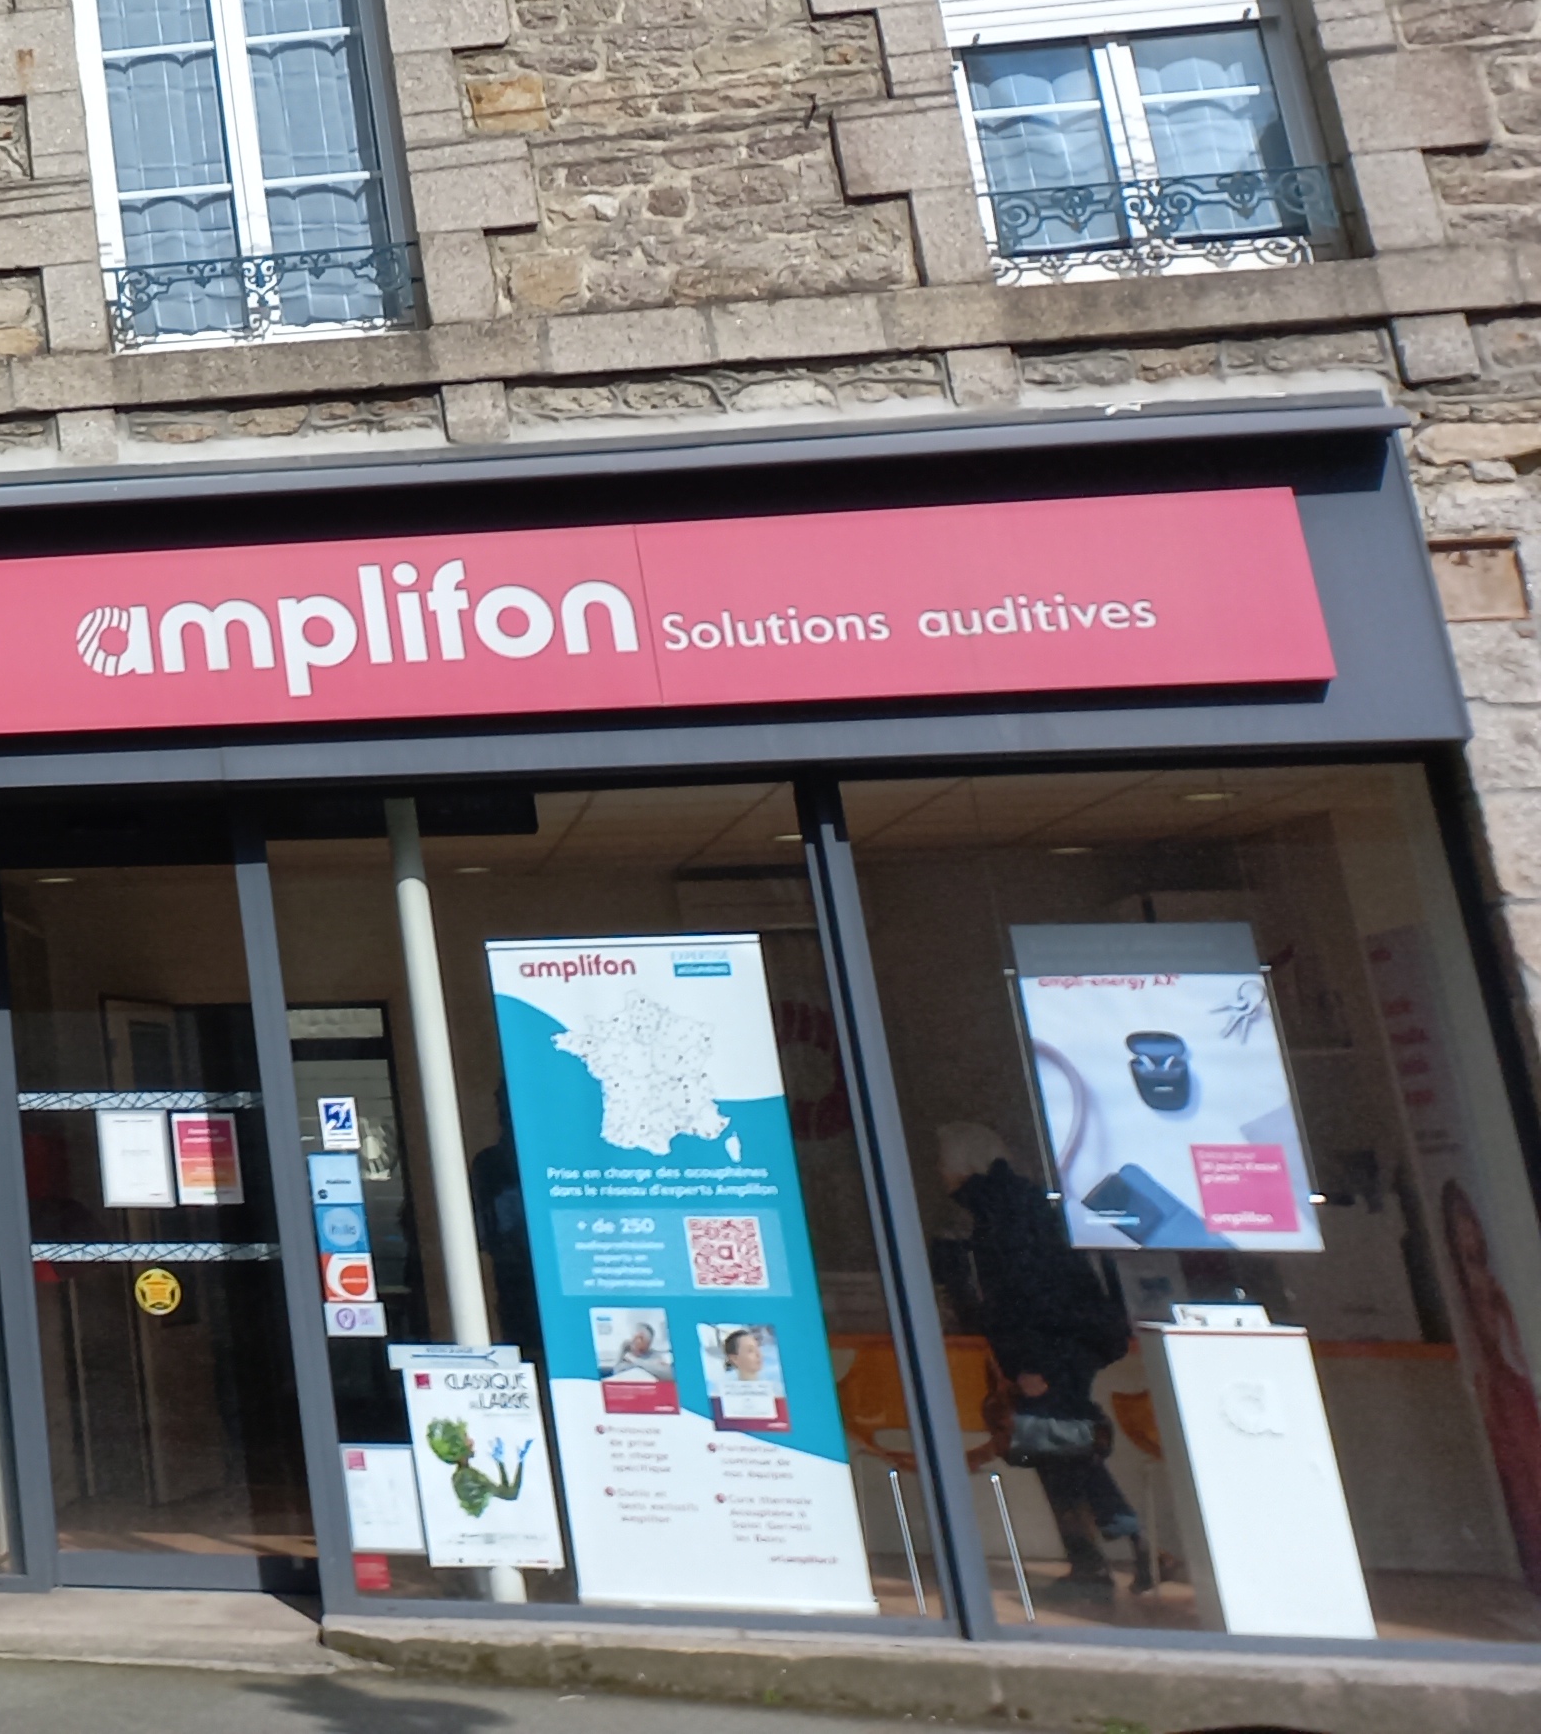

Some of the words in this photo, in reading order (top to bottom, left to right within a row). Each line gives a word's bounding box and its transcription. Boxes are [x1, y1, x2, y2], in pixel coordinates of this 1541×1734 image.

[75, 558, 640, 697] amplifon
[661, 607, 891, 651] Solutions
[918, 593, 1157, 638] auditives
[519, 954, 637, 983] amplifon
[547, 1167, 580, 1180] Prise
[583, 1170, 601, 1179] en
[604, 1168, 653, 1182] charge
[655, 1167, 681, 1179] des
[684, 1165, 769, 1180] acouphènes
[549, 1185, 583, 1197] dans
[584, 1184, 598, 1197] le
[600, 1184, 647, 1197] réseau
[715, 1183, 778, 1198] Amplifon
[591, 1218, 616, 1234] de
[619, 1217, 655, 1234] 250
[1211, 1210, 1274, 1228] amplifon
[444, 1372, 528, 1391] CLASSIQUE
[478, 1393, 531, 1410] LARGE
